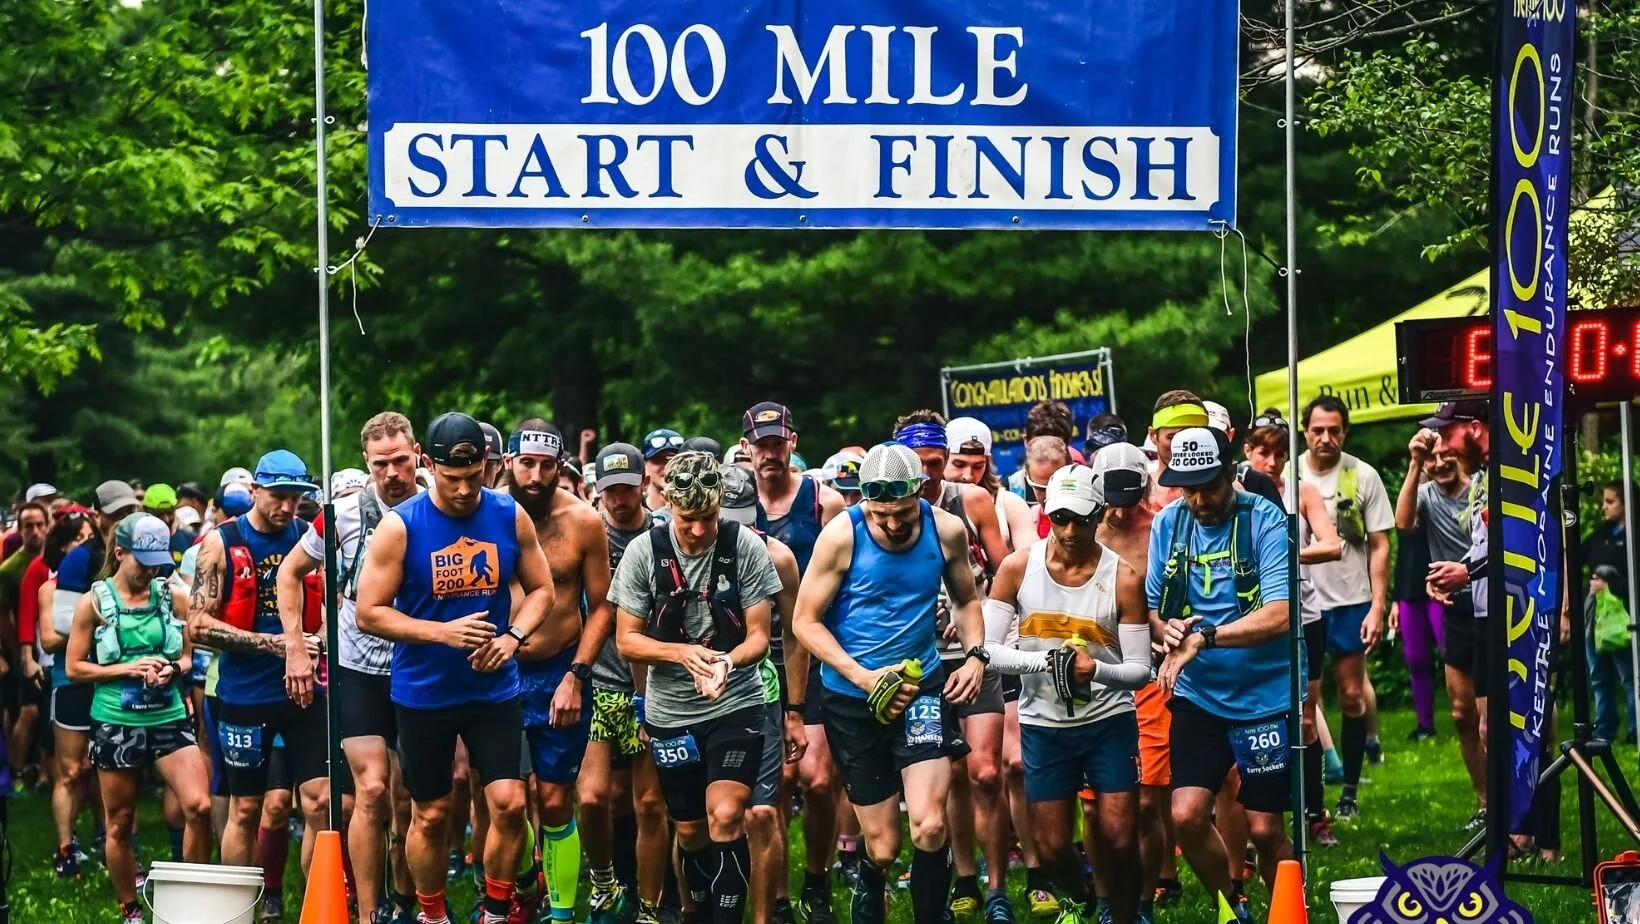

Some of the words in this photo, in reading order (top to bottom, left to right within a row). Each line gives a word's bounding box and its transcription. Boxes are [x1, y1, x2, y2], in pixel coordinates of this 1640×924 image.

[581, 22, 728, 106] 100
[766, 24, 1029, 107] MILE
[1548, 53, 1562, 155] RUNS
[407, 132, 695, 200] START
[744, 132, 819, 199] &
[870, 133, 1198, 202] FINISH
[1544, 174, 1558, 406] ENDURANCE
[1182, 441, 1199, 452] 50
[1183, 457, 1215, 466] GOOD
[435, 553, 464, 568] BIG
[436, 567, 464, 578] FOOT
[436, 578, 465, 591] 200
[1531, 612, 1550, 739] KETTLE
[908, 705, 941, 721] 125
[227, 732, 252, 748] 313
[1248, 731, 1281, 751] 260
[657, 746, 689, 763] 350
